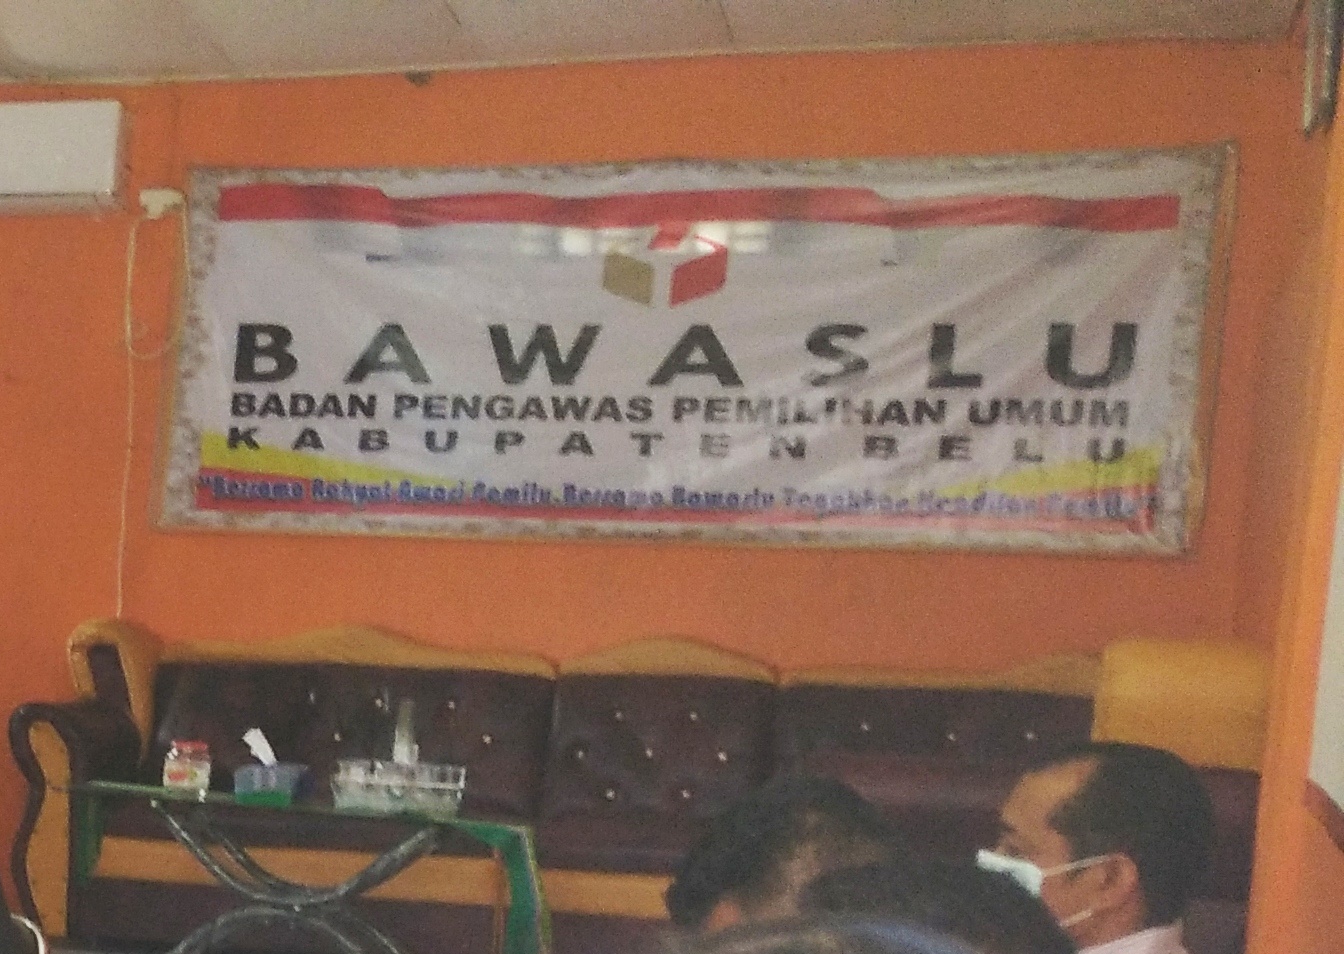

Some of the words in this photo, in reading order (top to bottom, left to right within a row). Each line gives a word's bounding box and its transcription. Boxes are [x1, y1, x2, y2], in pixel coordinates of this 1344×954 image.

[233, 322, 1139, 389] BAWASLU
[230, 393, 378, 420] BADAN
[394, 394, 653, 423] PENGAWAS
[672, 396, 952, 427] PEMILIHAN
[968, 398, 1130, 428] UMUM
[226, 426, 807, 461] KABUPATEN
[863, 434, 1126, 465] BELU
